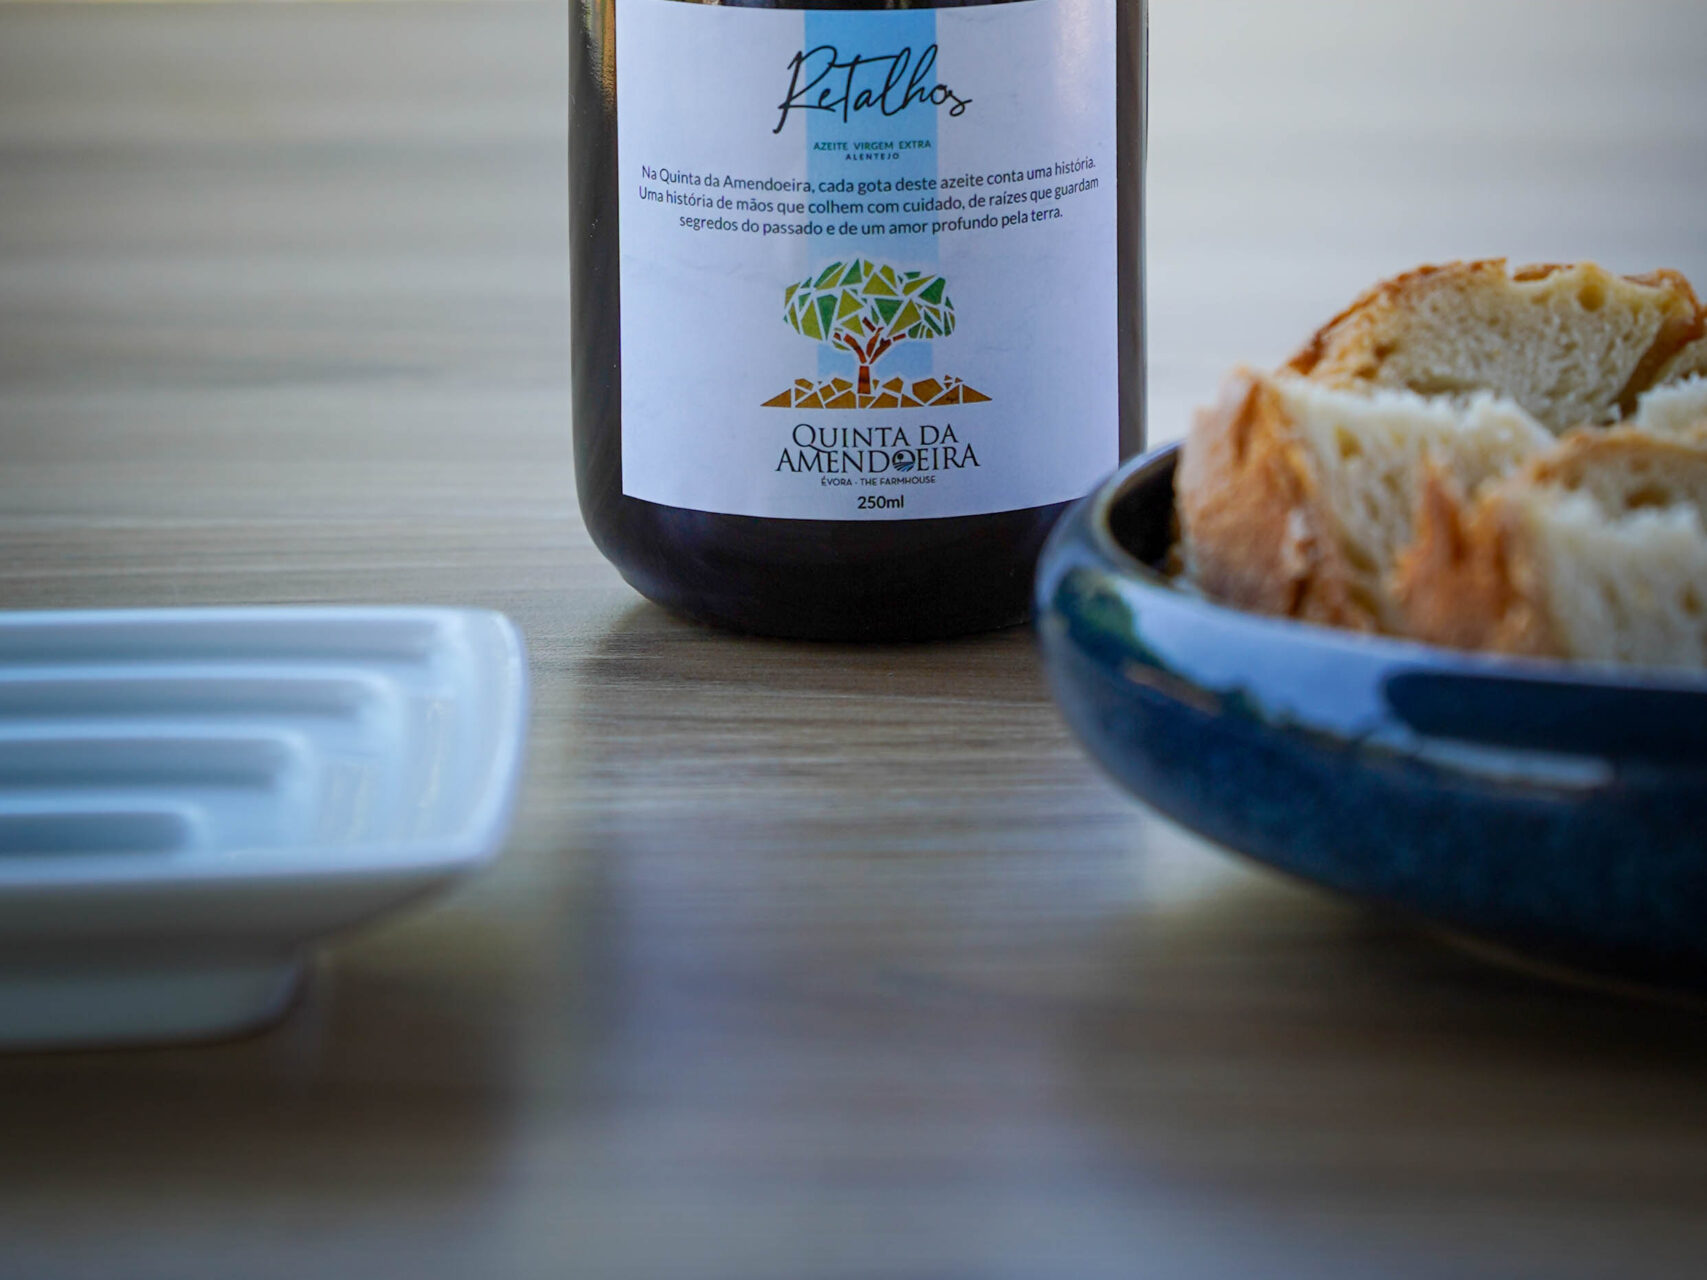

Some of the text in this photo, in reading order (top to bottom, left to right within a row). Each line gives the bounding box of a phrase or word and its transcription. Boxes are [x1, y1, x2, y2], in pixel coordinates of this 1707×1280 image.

[813, 140, 931, 151] AZEITE VIRGEM EXTRA
[845, 152, 900, 160] ALENTEJO
[642, 156, 1096, 195] Na Quinta da Amendoeira, cada gota deste azeite conta uma história.
[639, 177, 1099, 215] Uma história de mãos que colhem com cuidado, de raízes que guardam
[679, 206, 1063, 236] segredos do passado e de um amor profundo pela terra.
[792, 423, 959, 452] QUINTA DA
[776, 443, 981, 473] AMENDOEIRA
[821, 475, 852, 486] ÉVORA
[860, 477, 877, 486] THE
[880, 475, 936, 485] FARMHOUSE
[858, 495, 904, 509] 250ml
